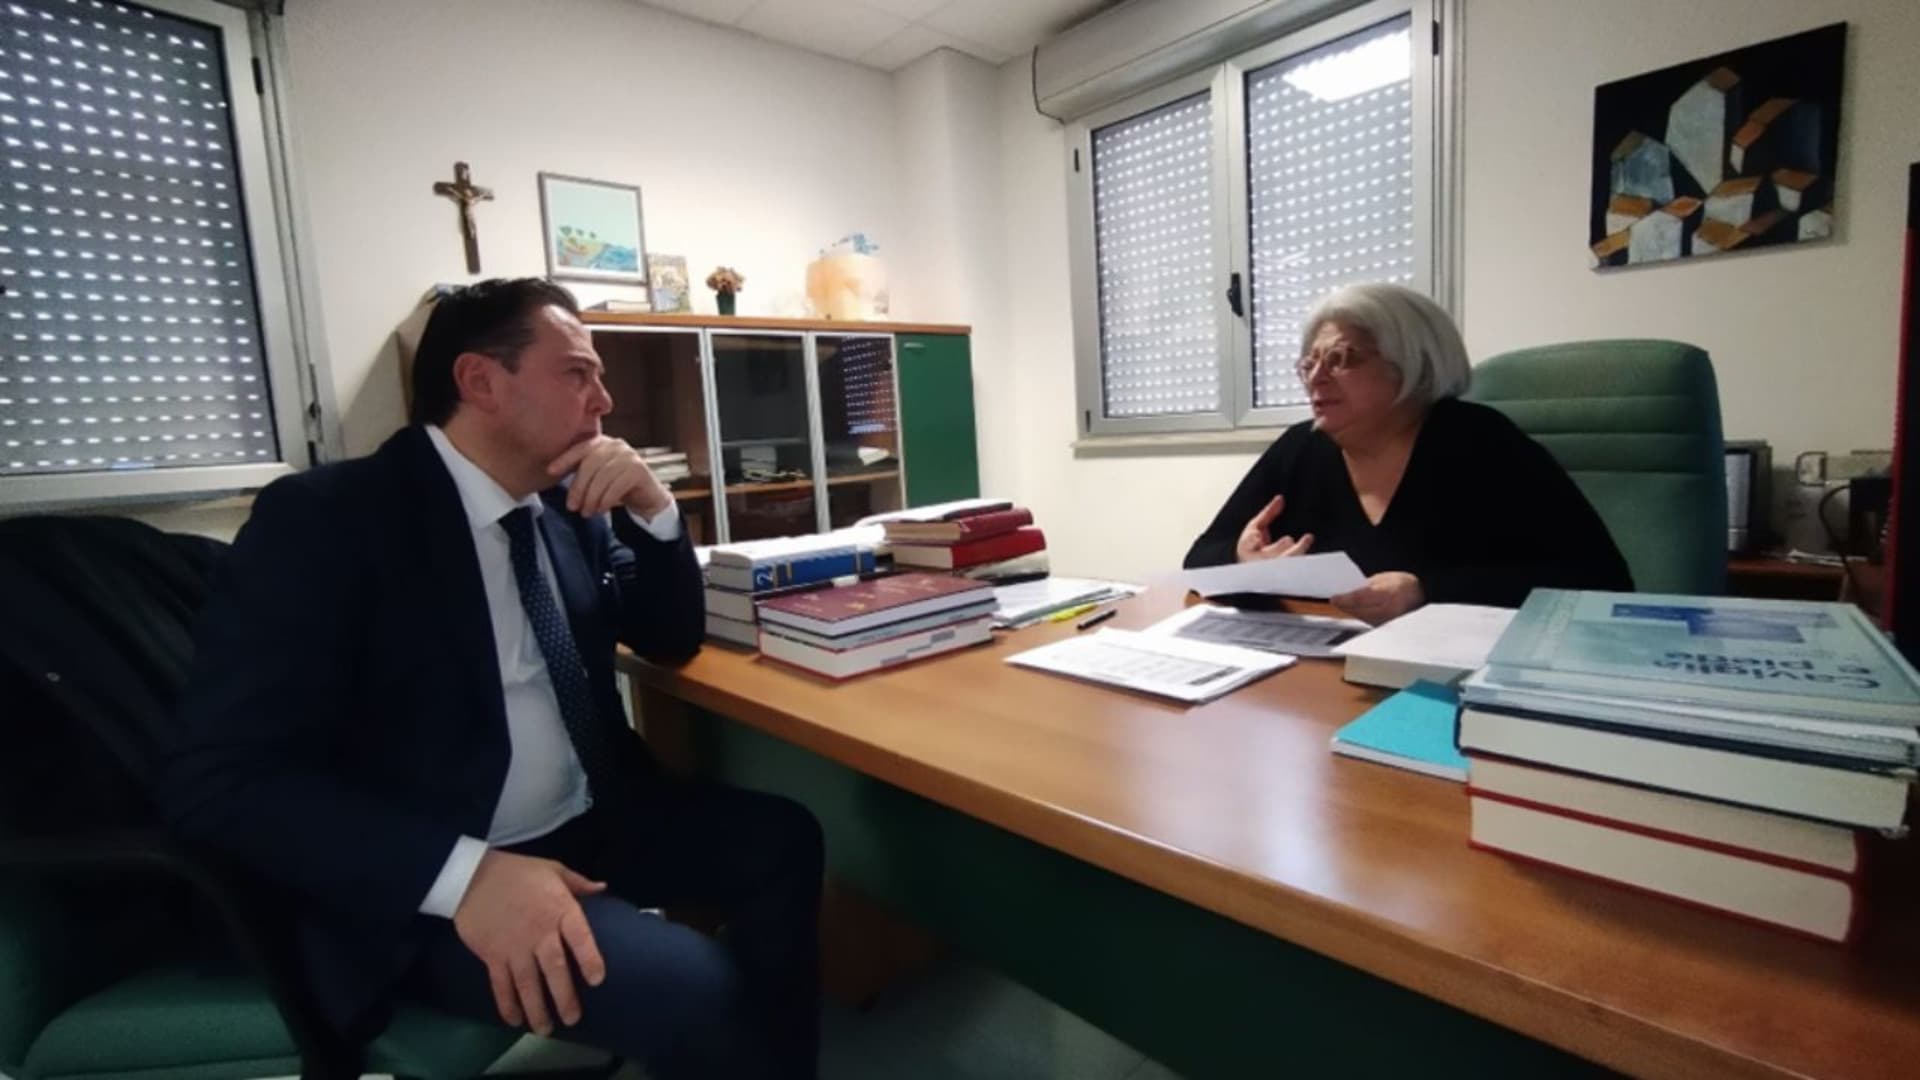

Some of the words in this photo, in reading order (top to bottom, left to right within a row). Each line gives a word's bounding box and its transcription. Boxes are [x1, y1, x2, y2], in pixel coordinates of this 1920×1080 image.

[1664, 652, 1815, 671] piede
[1838, 664, 1871, 675] e
[1652, 661, 1881, 689] Caviglia
